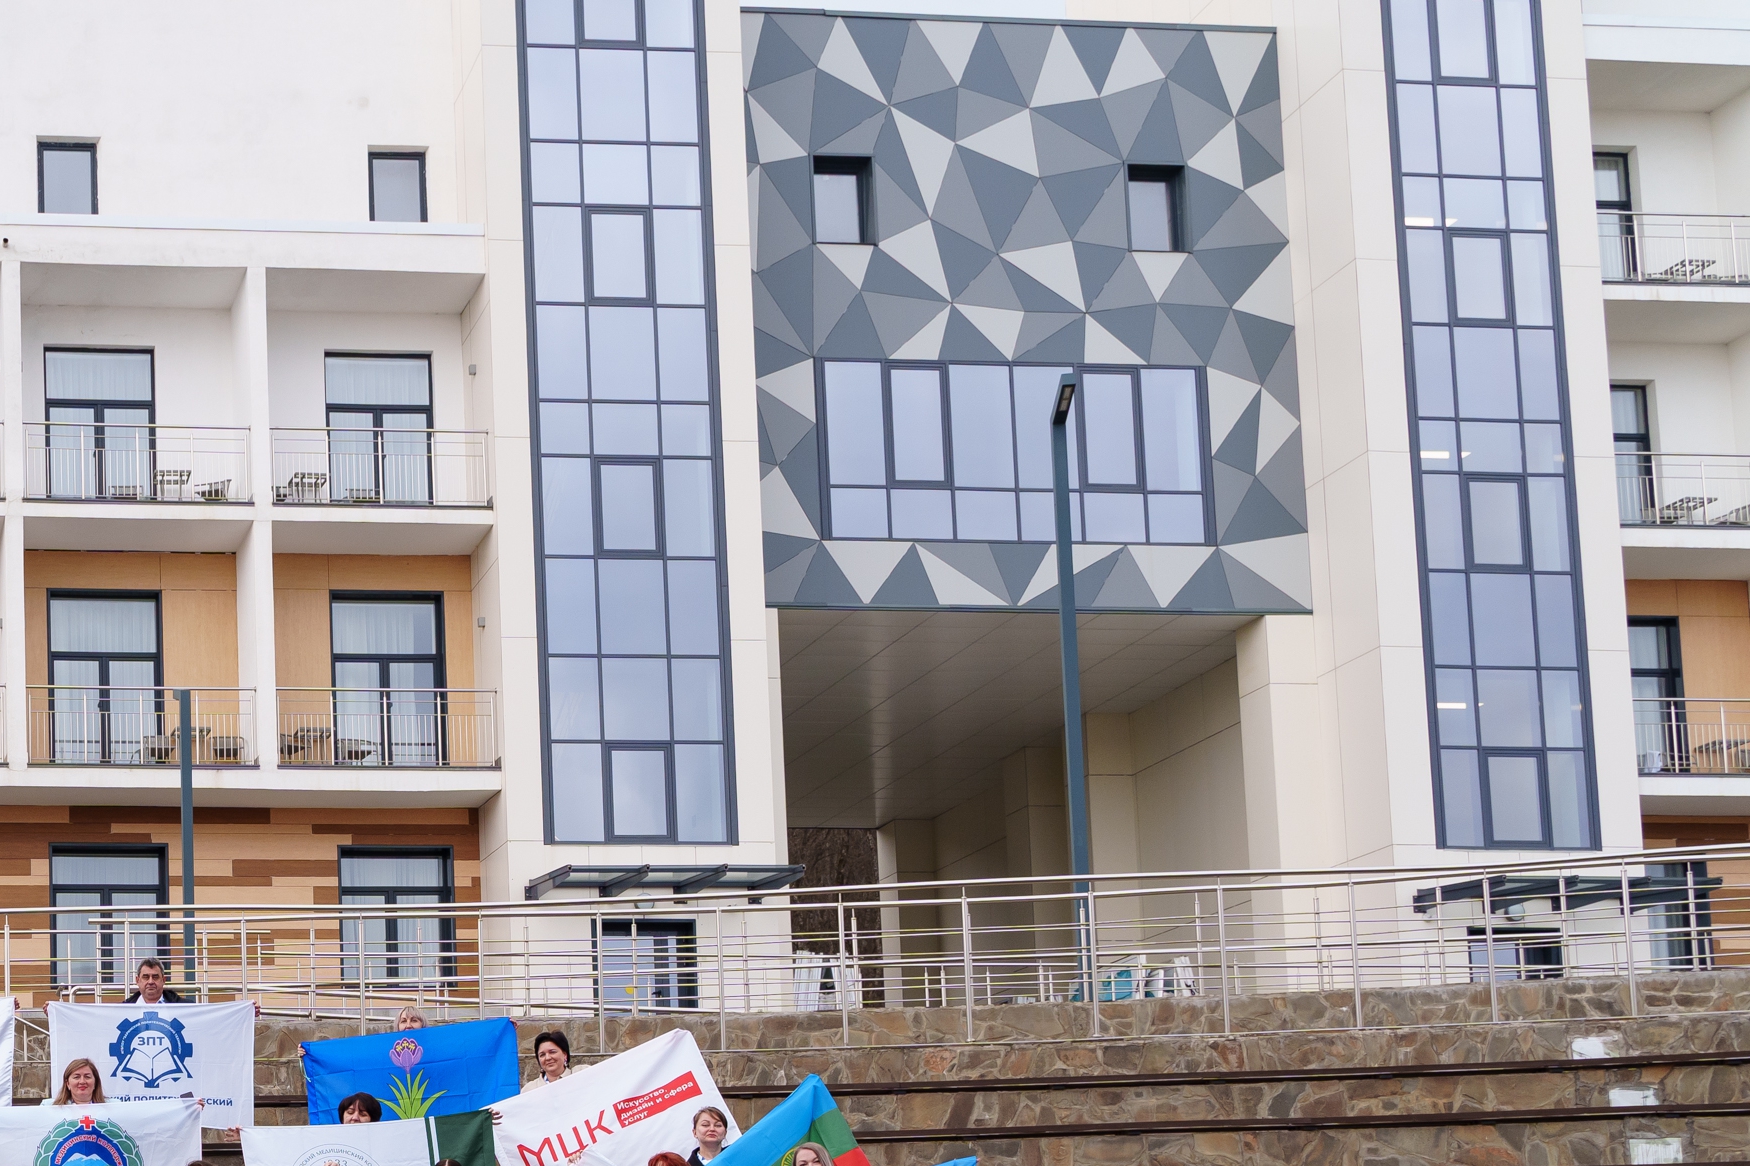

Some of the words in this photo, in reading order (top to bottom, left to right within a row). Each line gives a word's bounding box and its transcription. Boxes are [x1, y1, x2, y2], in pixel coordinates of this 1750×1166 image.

[138, 1037, 165, 1046] ЗПТ
[617, 1089, 667, 1110] Искусство,
[621, 1101, 654, 1119] дизайн
[664, 1081, 693, 1099] сфера
[623, 1111, 648, 1125] услуг
[55, 1135, 97, 1165] МЕДИЦИНСКИЙ
[316, 1148, 364, 1161] МЕДИЦИНСКИЙ
